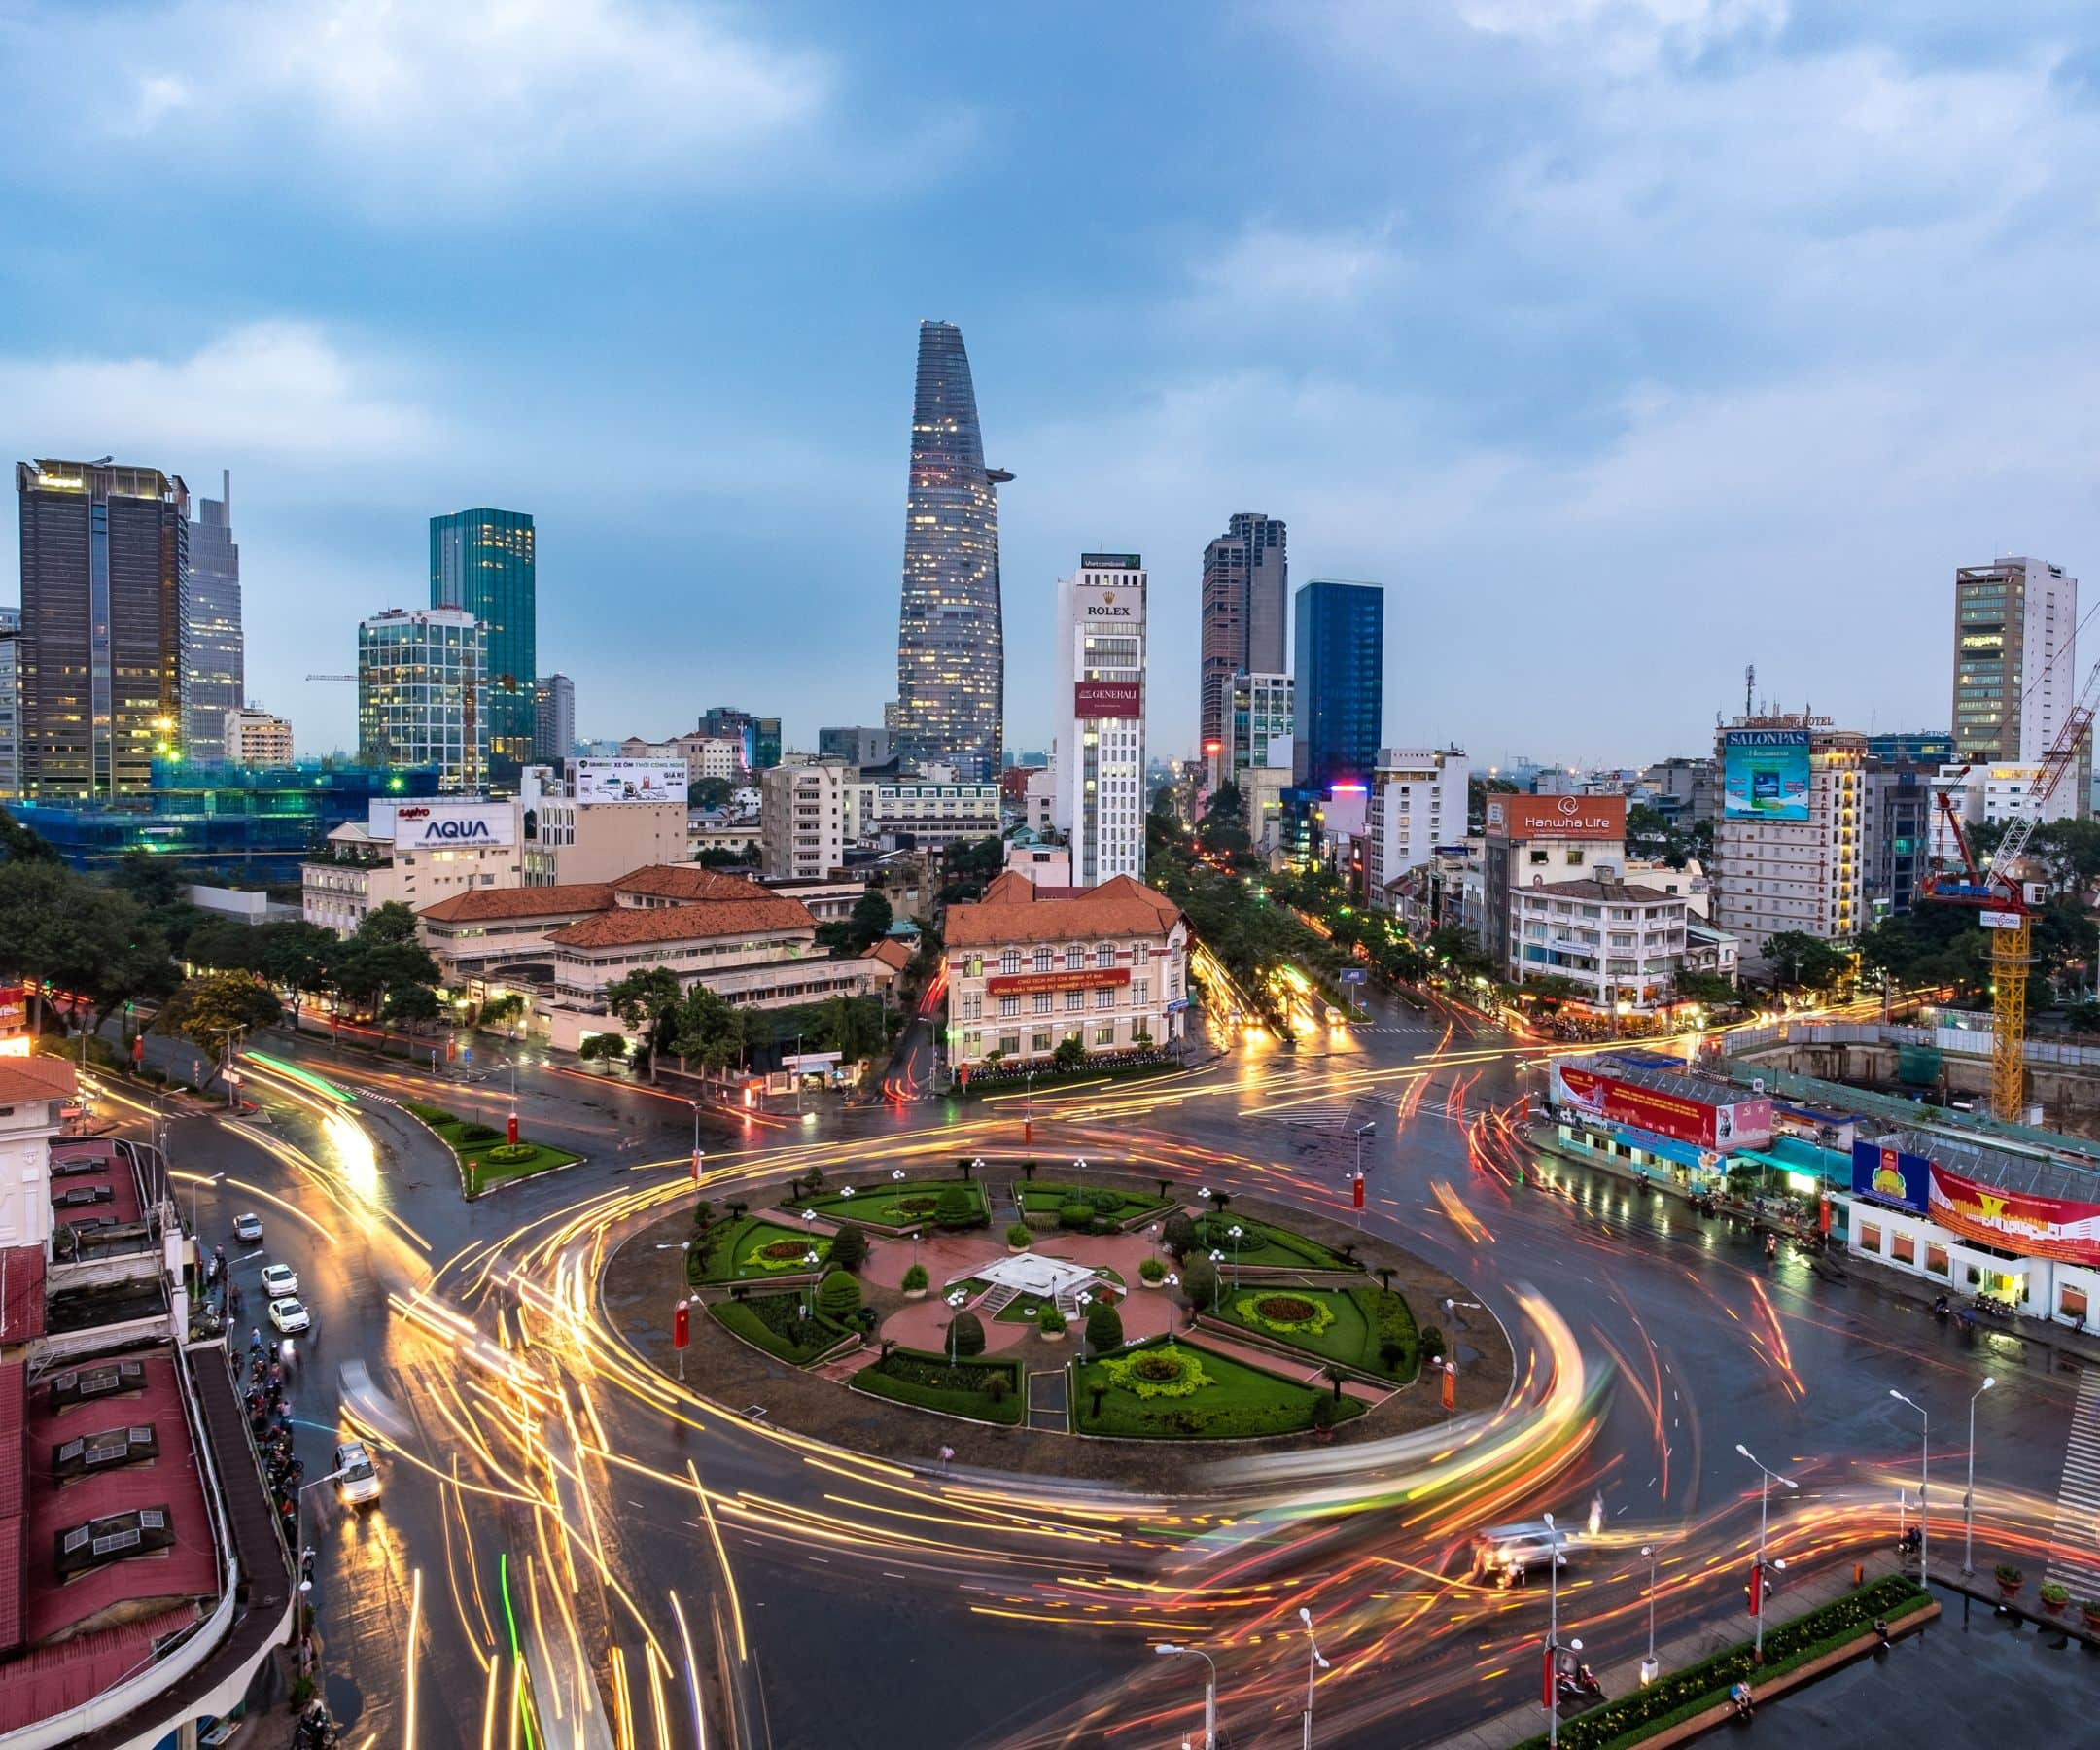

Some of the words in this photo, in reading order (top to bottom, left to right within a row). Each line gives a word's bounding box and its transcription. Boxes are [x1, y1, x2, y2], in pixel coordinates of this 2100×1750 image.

[1087, 606, 1131, 616] ROLEX
[1092, 690, 1137, 700] GENERALI
[1731, 731, 1805, 746] SALONPAS
[1525, 817, 1583, 828] Hanwha
[1585, 817, 1610, 828] Life
[425, 821, 489, 839] AQUA
